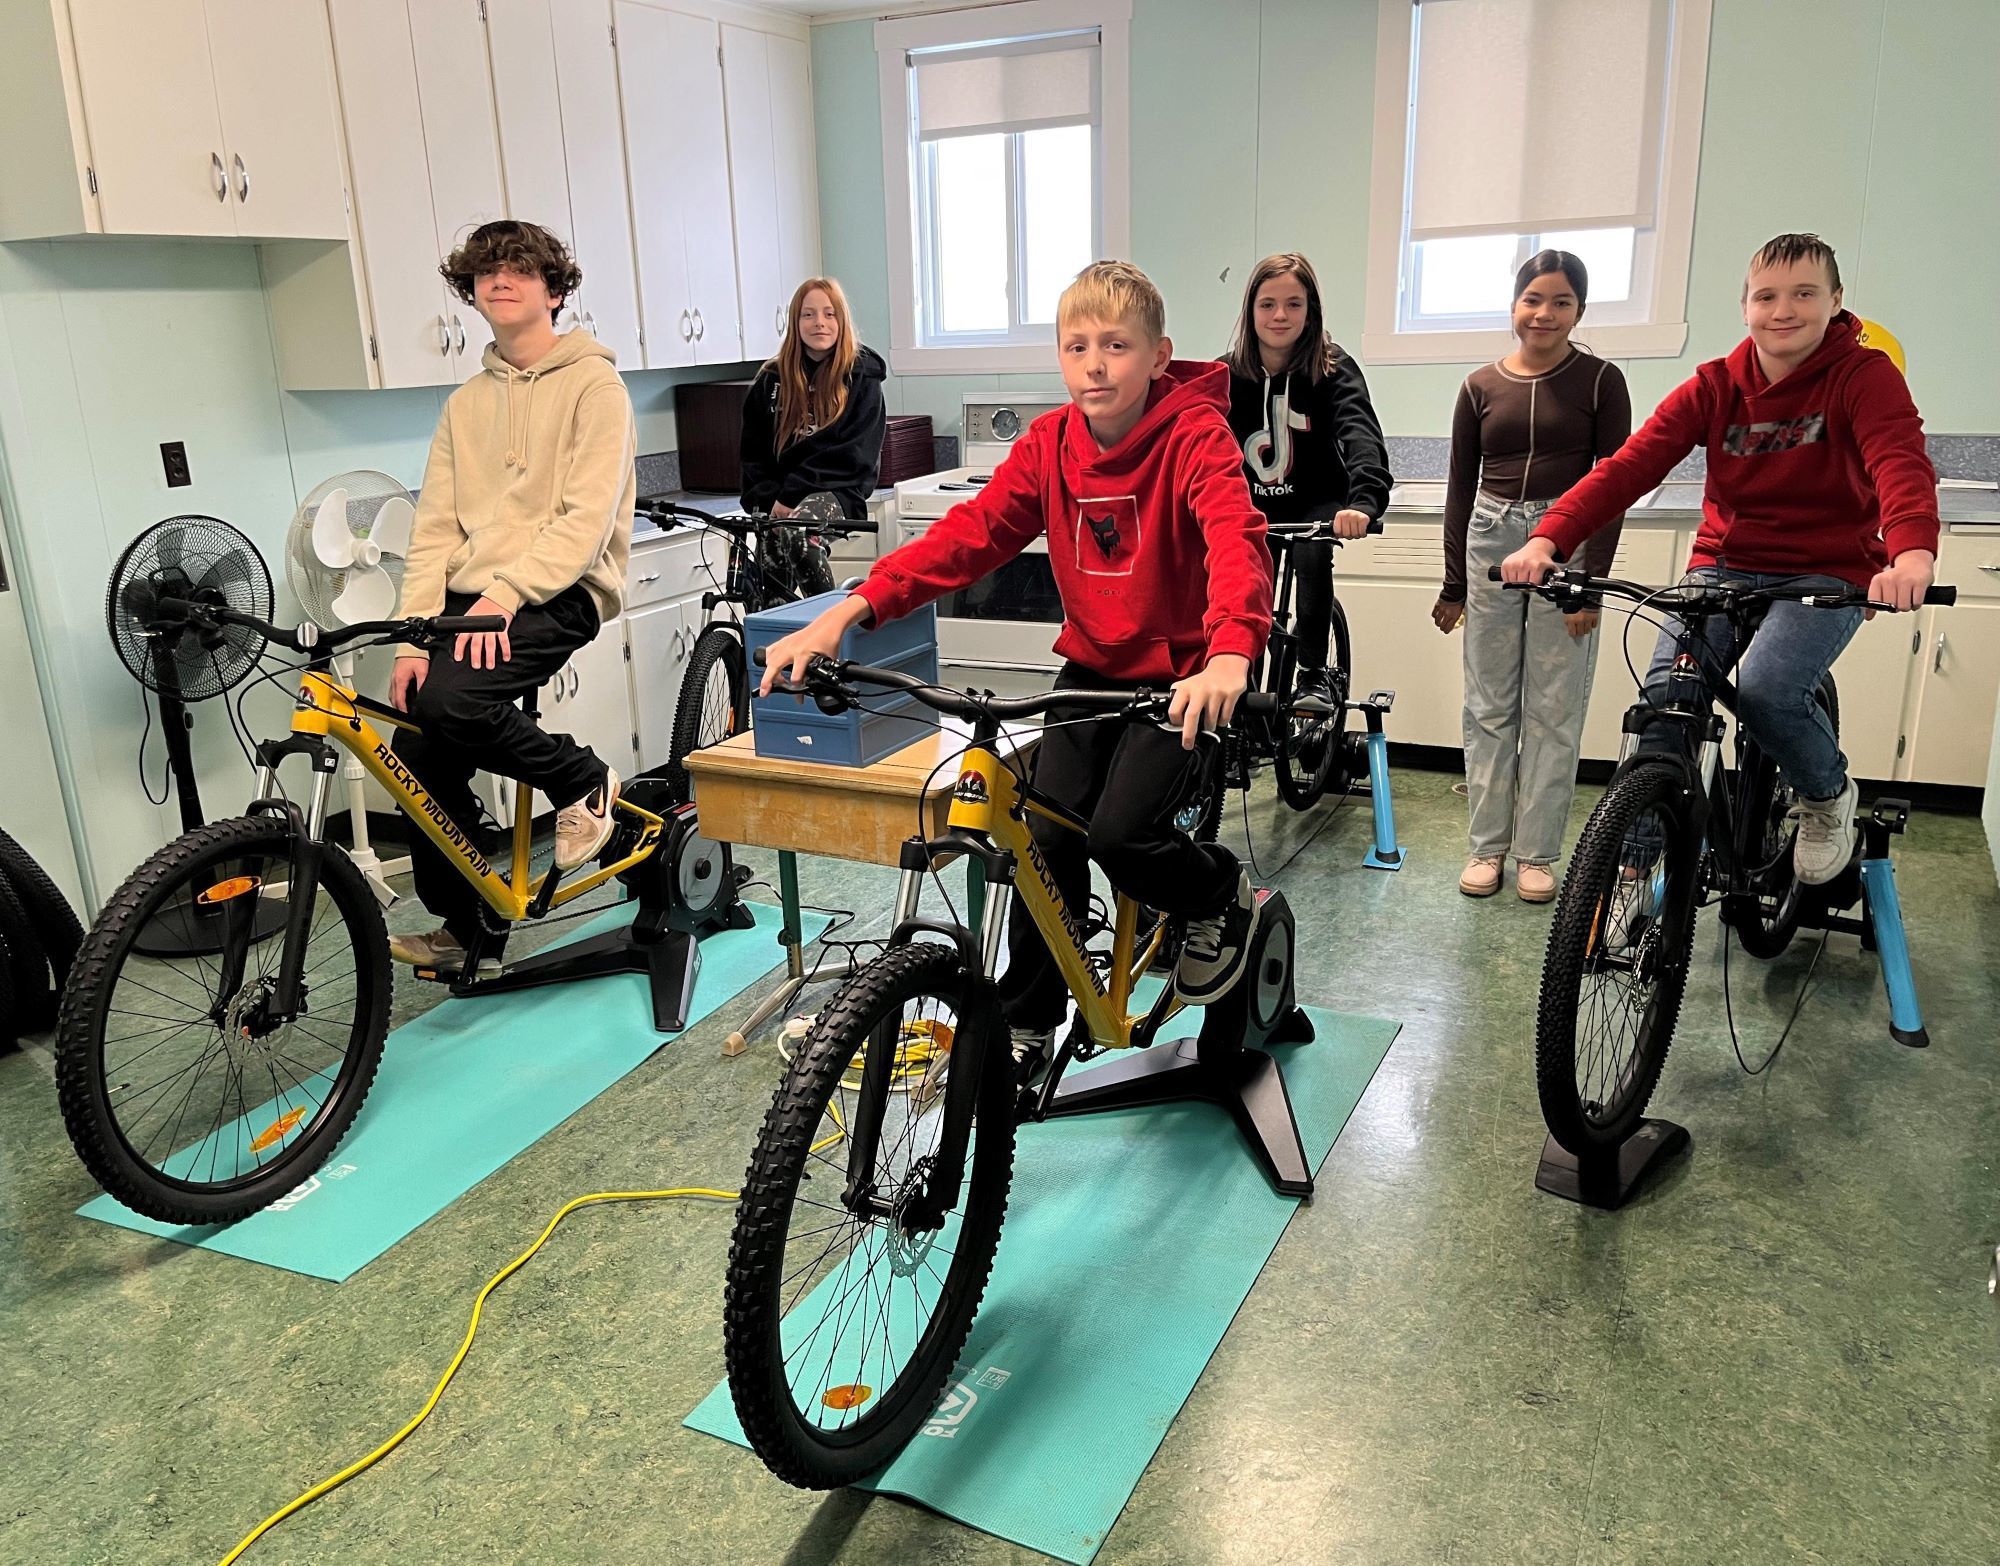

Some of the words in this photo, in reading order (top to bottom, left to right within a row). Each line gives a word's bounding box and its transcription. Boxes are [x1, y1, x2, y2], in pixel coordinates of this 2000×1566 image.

[1253, 483, 1294, 496] TikTok
[374, 743, 424, 797] ROCKY
[421, 798, 493, 878] MOUNTAIN
[1026, 840, 1060, 904] ROCKY
[1057, 905, 1107, 998] MOUNTAIN
